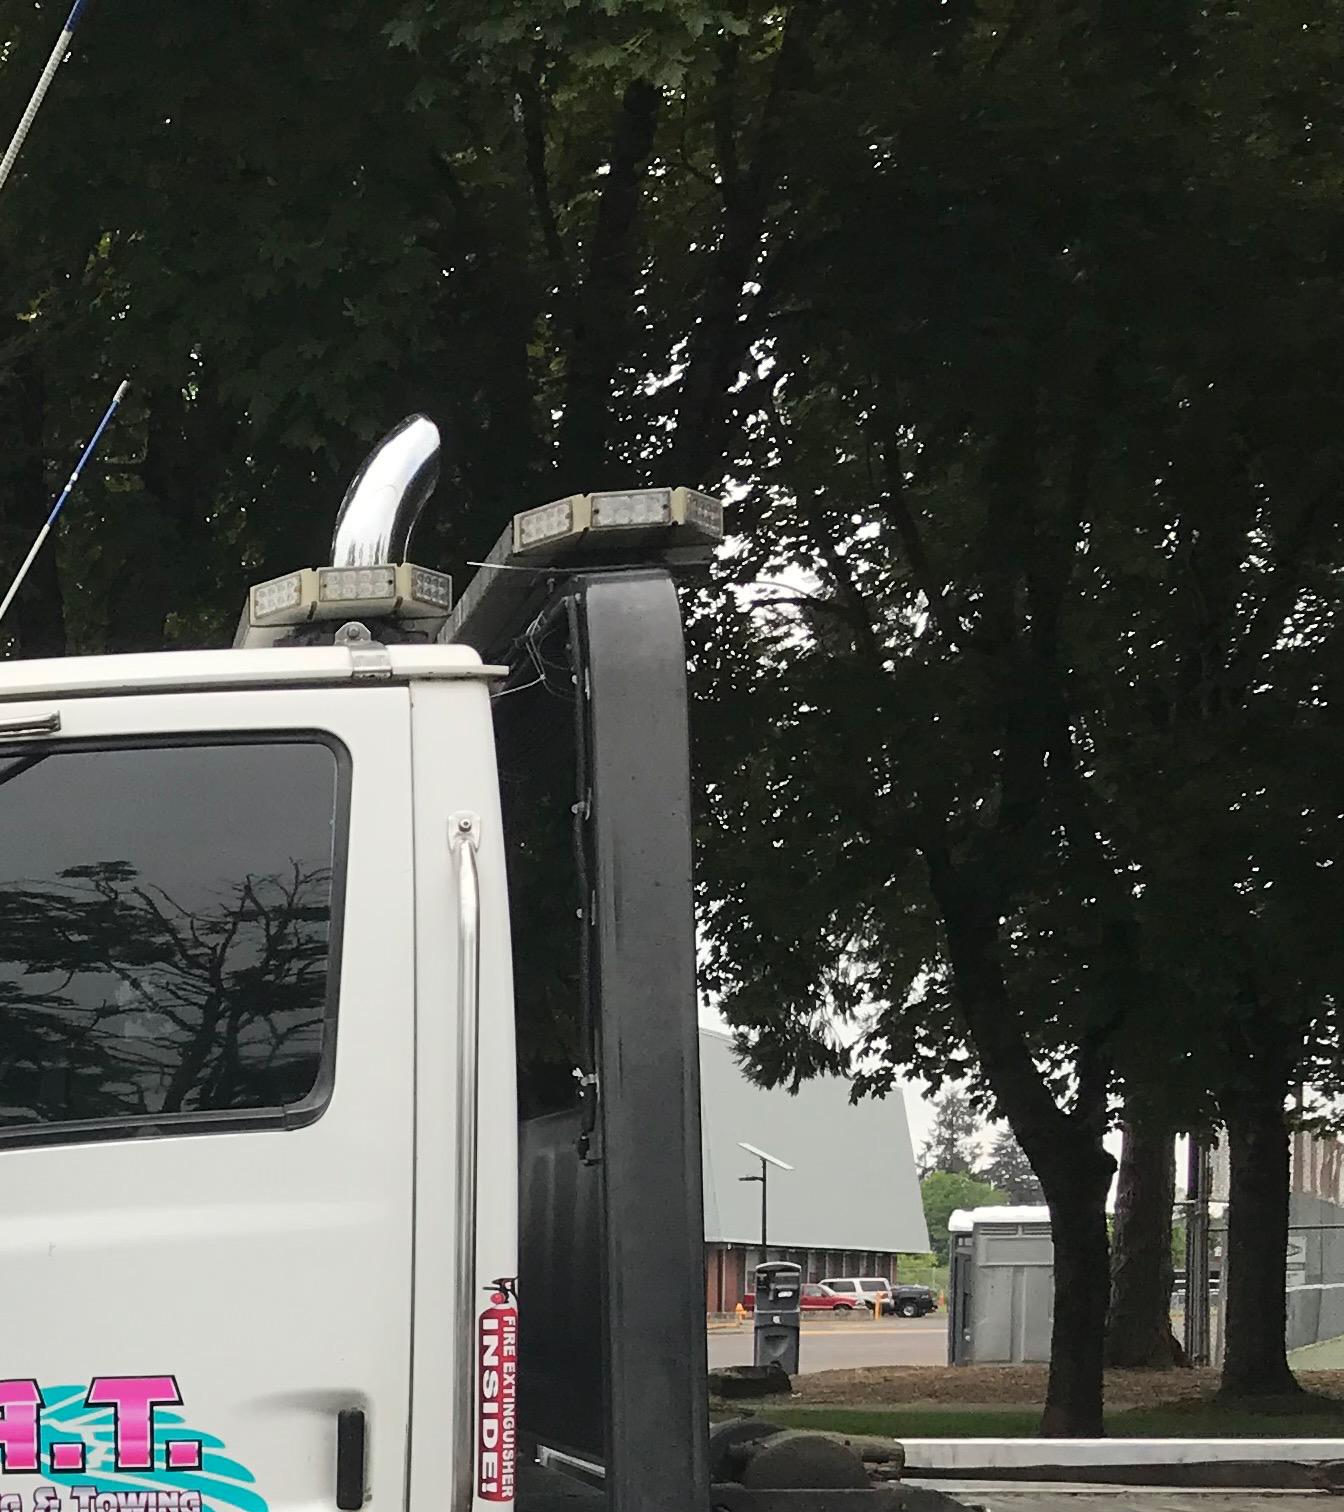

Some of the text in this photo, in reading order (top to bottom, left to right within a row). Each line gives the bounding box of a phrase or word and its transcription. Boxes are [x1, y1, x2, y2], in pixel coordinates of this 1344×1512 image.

[481, 1318, 499, 1493] INSIDE!
[501, 1315, 516, 1498] FIRE EXTINGUISHER
